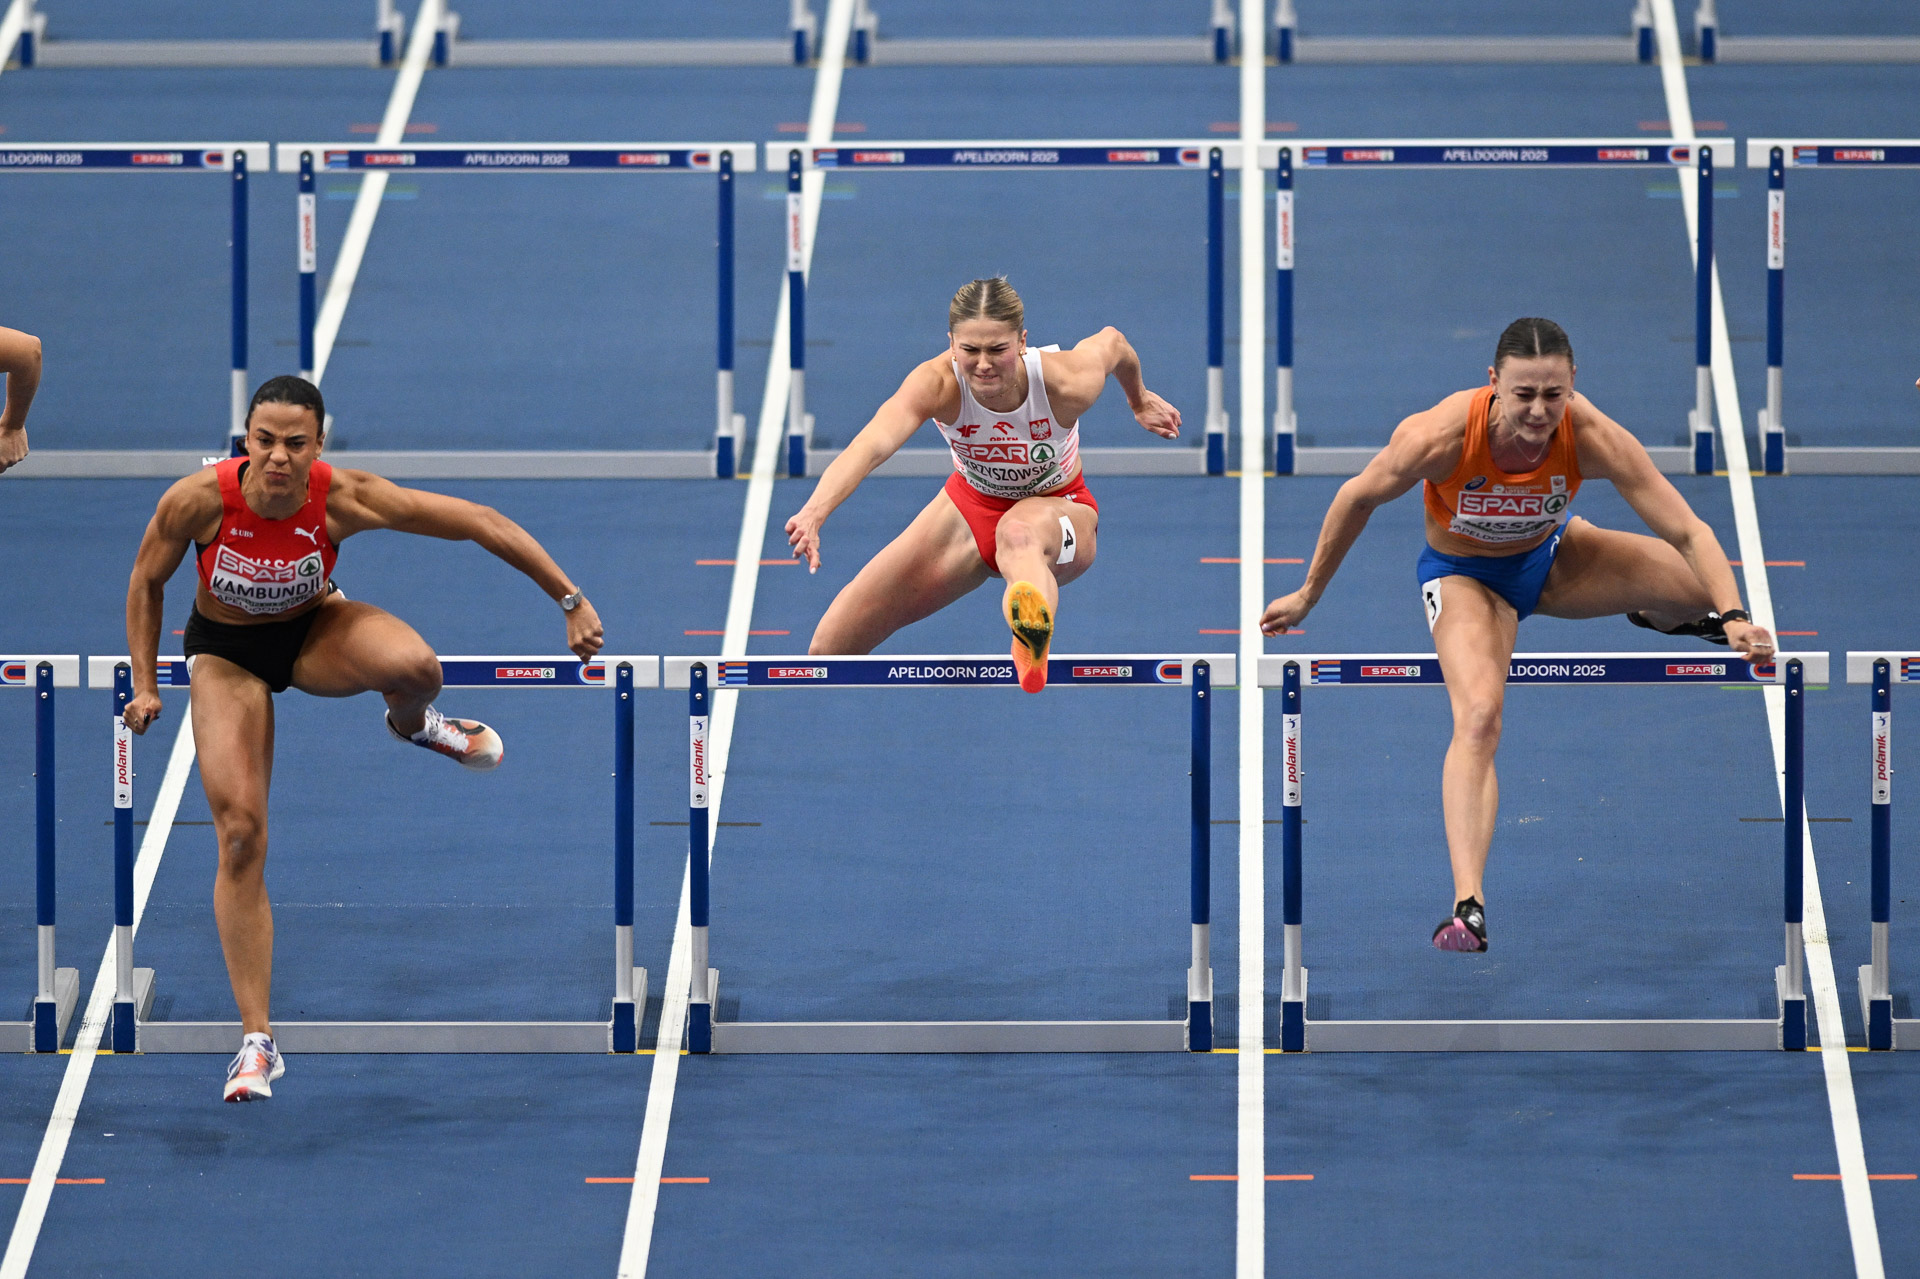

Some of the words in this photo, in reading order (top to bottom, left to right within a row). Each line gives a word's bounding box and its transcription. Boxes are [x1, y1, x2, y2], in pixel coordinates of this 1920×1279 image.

[1, 152, 53, 165] LDOORN
[55, 152, 83, 165] 2025
[465, 152, 539, 165] APELDOORN
[541, 152, 570, 165] 2025
[953, 151, 1028, 163] APELDOORN
[1031, 151, 1059, 163] 2025
[1443, 149, 1518, 161] APELDOORN
[1520, 149, 1548, 161] 2025
[951, 441, 1026, 462] SPAR
[1462, 497, 1540, 513] SPAR
[239, 529, 254, 538] UBS
[1063, 528, 1074, 550] 4
[220, 552, 294, 581] SPAR
[212, 575, 320, 600] KAMBUNDJI
[506, 669, 541, 677] SPAR
[778, 669, 813, 677] SPAR
[888, 666, 977, 679] APELDOORN
[980, 666, 1013, 679] 2025
[1372, 667, 1407, 675] SPAR
[1508, 664, 1569, 676] LDOORN
[1573, 664, 1606, 676] 2025
[1676, 666, 1711, 674] SPAR
[118, 737, 129, 785] polanik
[694, 738, 706, 786] polanik
[1288, 736, 1299, 783] polanik
[1875, 734, 1888, 781] polanik
